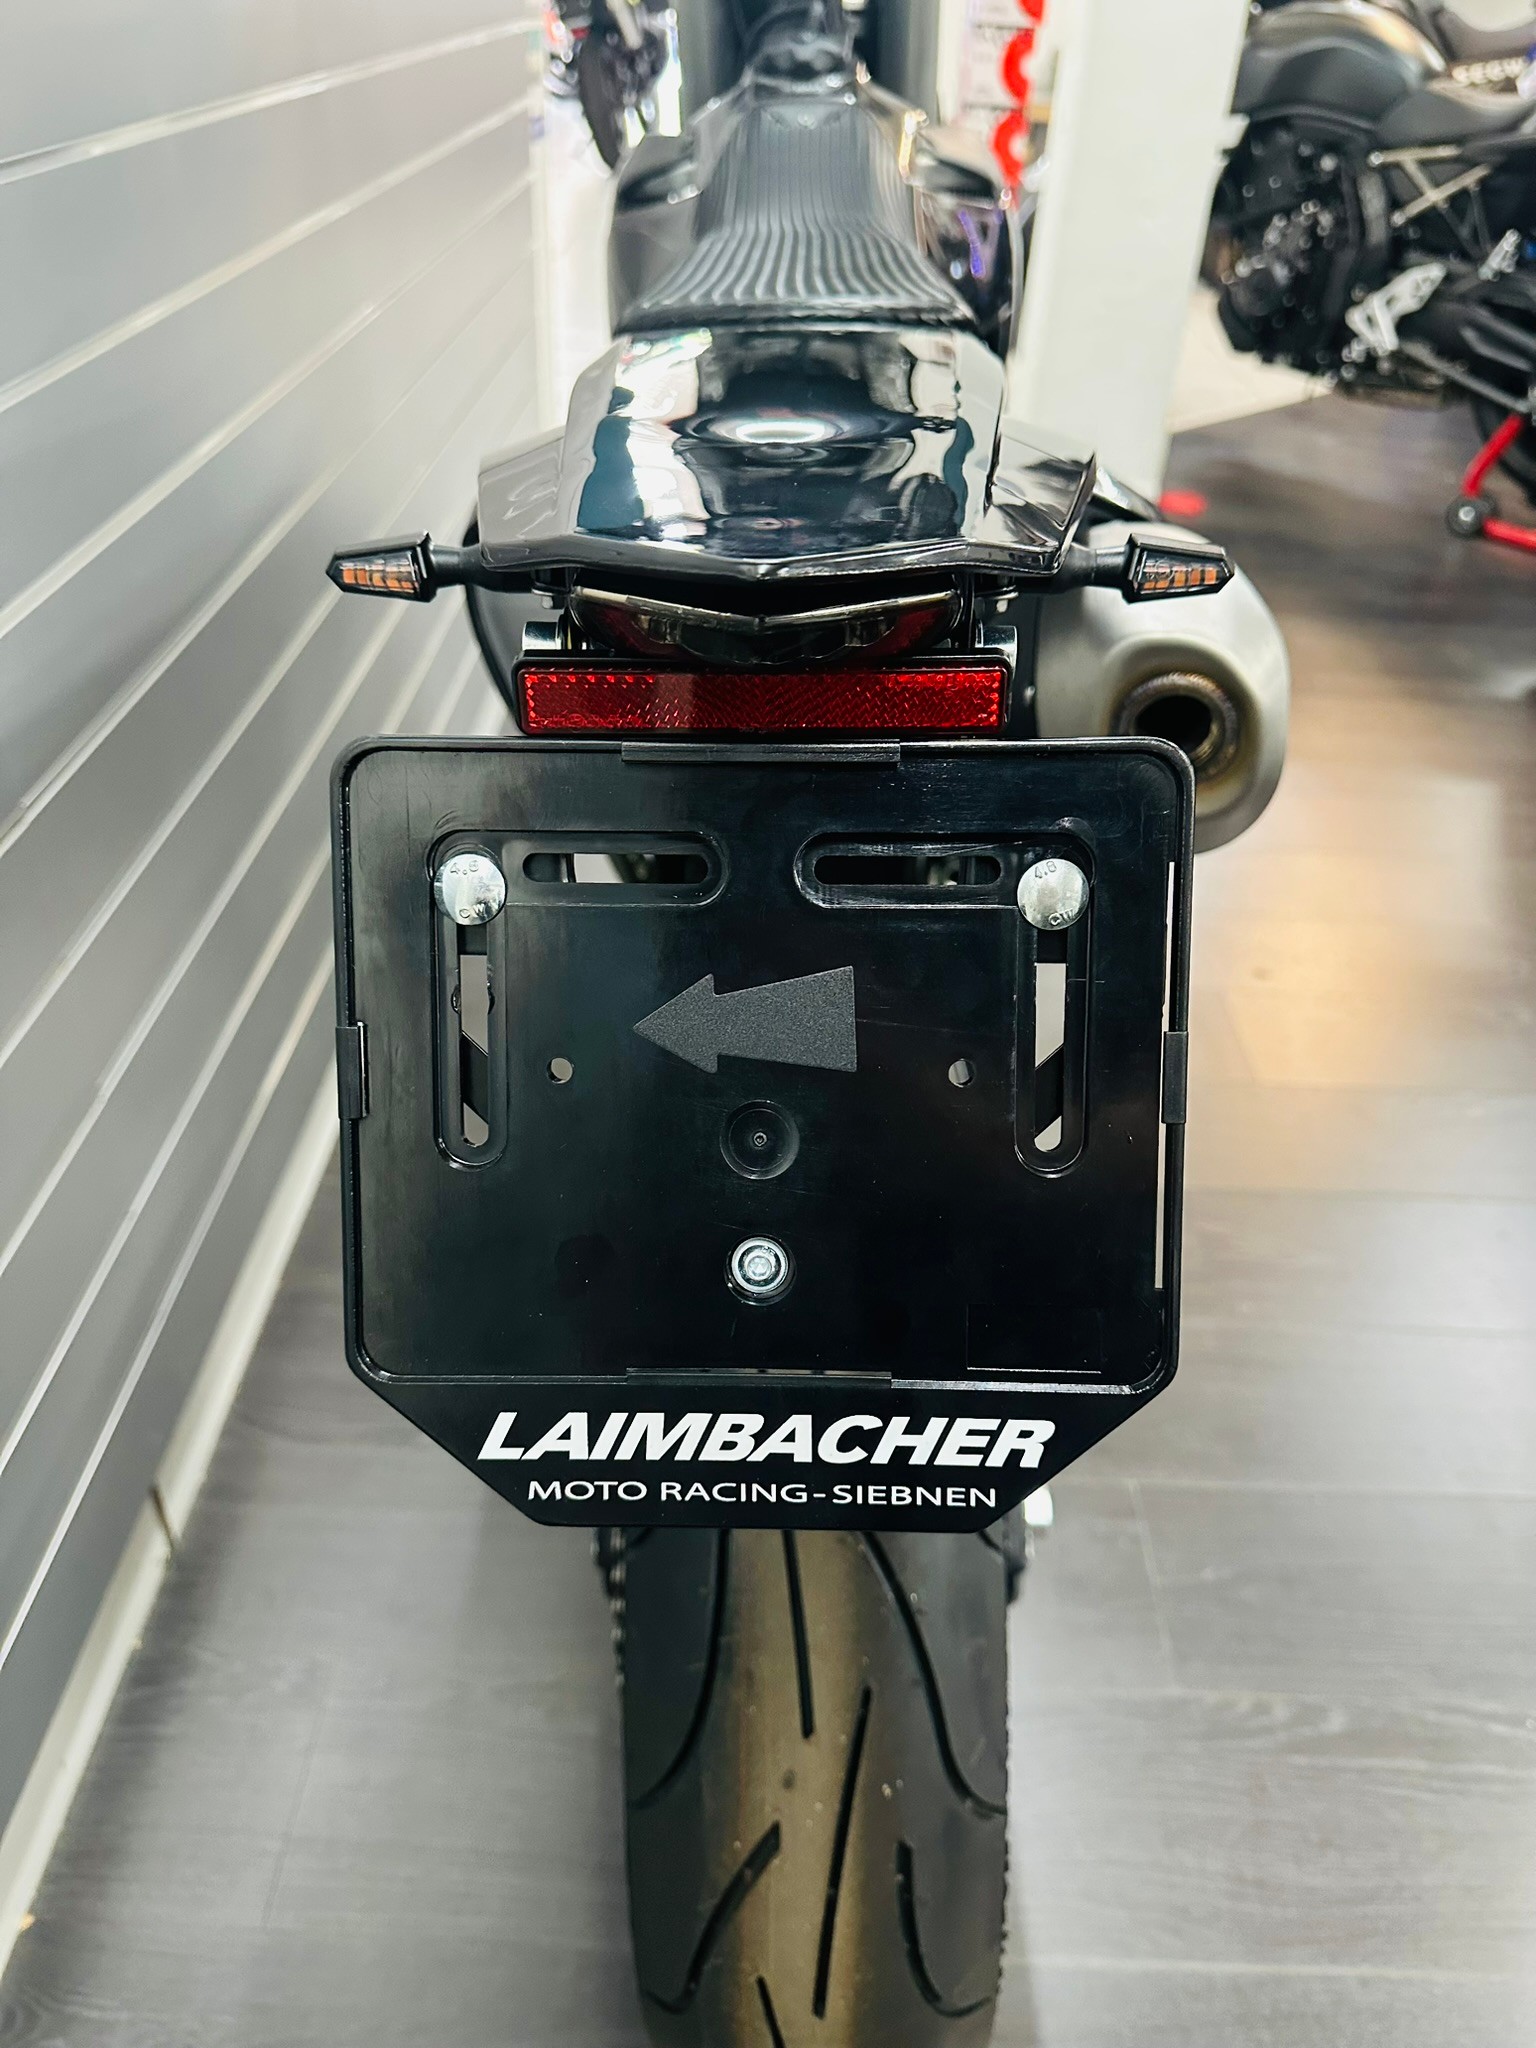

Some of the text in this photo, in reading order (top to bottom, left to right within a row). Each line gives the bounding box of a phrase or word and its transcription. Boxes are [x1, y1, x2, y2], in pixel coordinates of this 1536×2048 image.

[1034, 860, 1058, 879] 4.8
[477, 1411, 1056, 1469] LAIMBACHER
[527, 1480, 997, 1508] MOTO RACING-SIEBNEN
